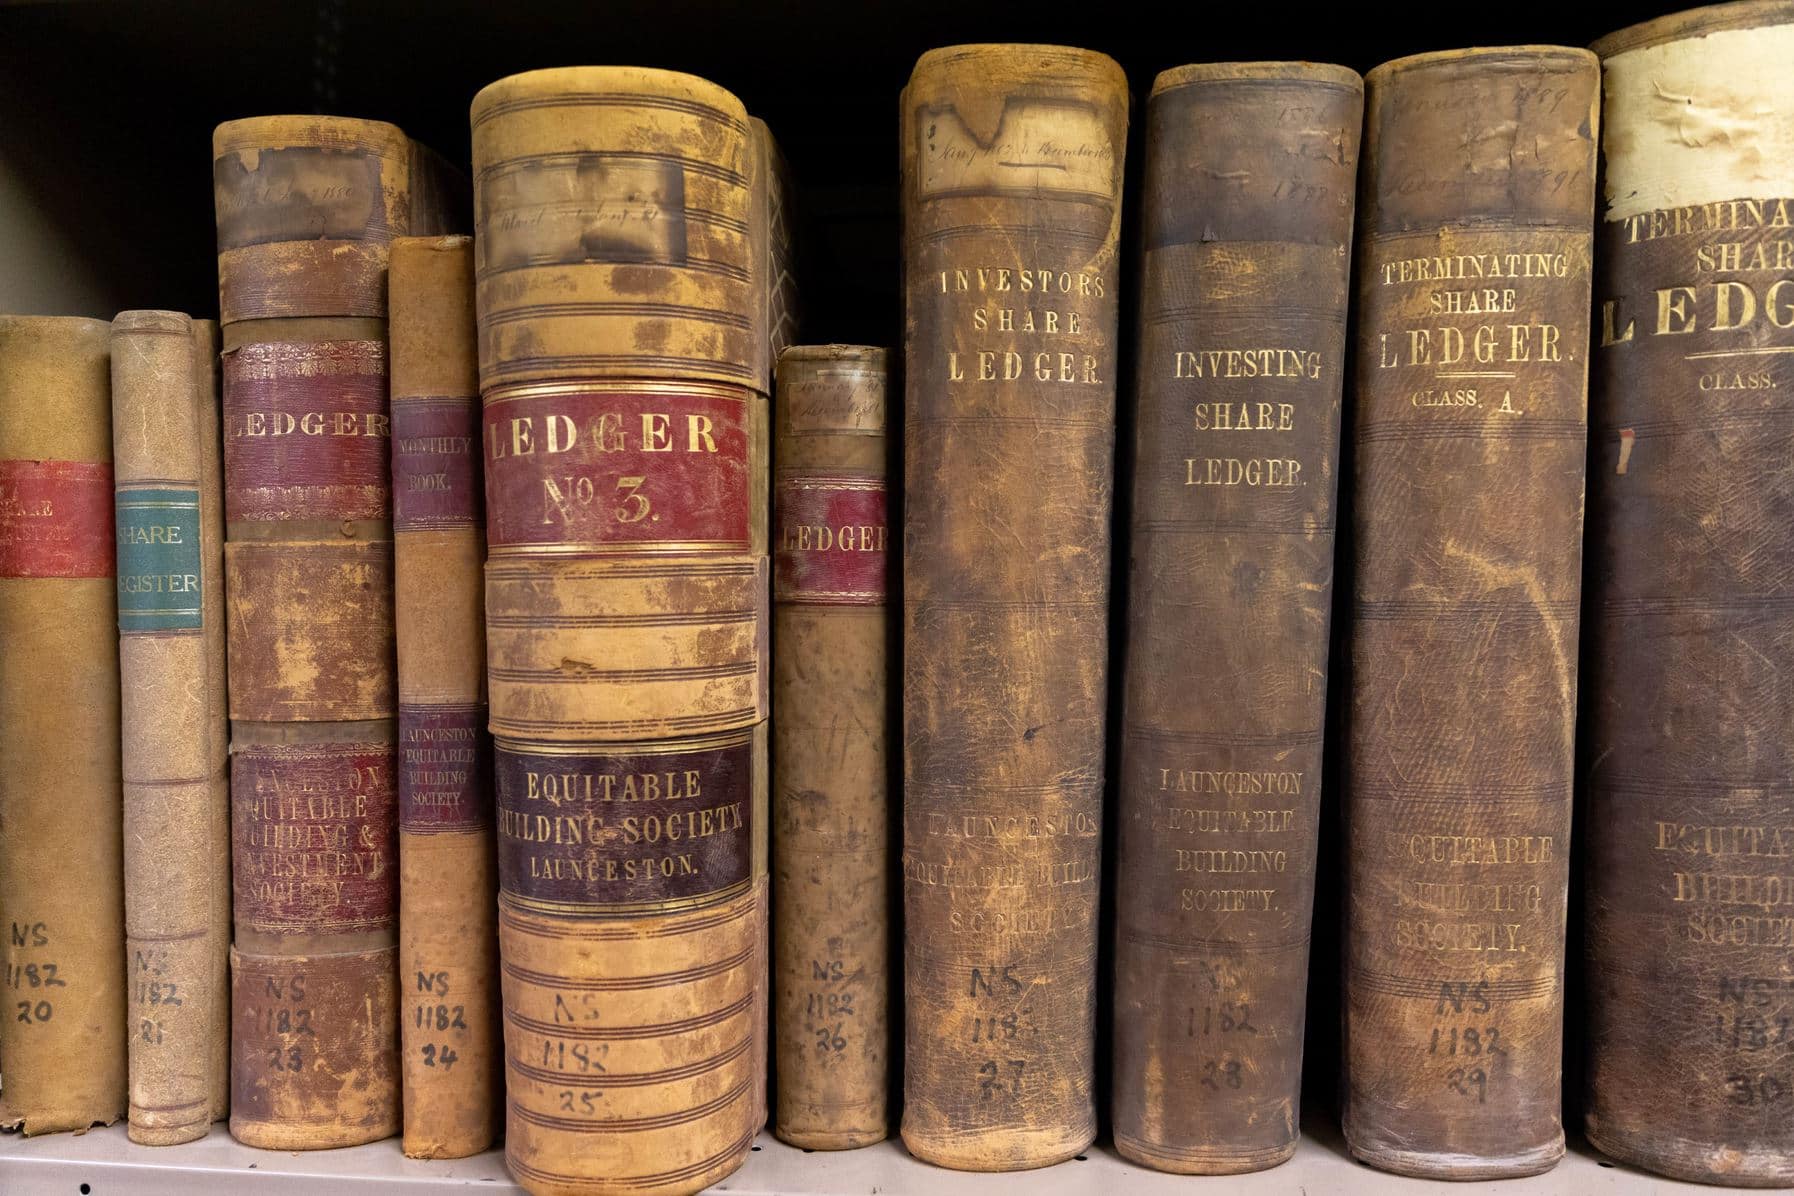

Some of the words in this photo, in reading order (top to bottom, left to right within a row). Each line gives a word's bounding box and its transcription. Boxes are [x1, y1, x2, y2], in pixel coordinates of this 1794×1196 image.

[941, 267, 1105, 298] INVESTORS
[1380, 253, 1569, 287] TERMINATING
[1429, 289, 1517, 315] SHARE
[973, 308, 1081, 335] SHARE
[1378, 323, 1574, 369] LEDGER.
[948, 351, 1104, 385] LEDGER.
[1173, 349, 1322, 380] INVESTING
[1700, 372, 1777, 391] CLASS.
[1411, 389, 1484, 409] CLASS.
[1498, 390, 1525, 415] A.
[1195, 402, 1295, 431] SHARE
[490, 413, 718, 460] LEDGER
[119, 526, 182, 545] HARE
[119, 574, 199, 593] EGISTER
[526, 770, 701, 807] EQUITABLE
[359, 825, 376, 849] &
[499, 806, 605, 846] BUILDING
[1175, 849, 1288, 873] BUILDING
[1397, 833, 1554, 865] QUITABLE
[531, 853, 698, 881] LAUNCESTON.
[12, 922, 48, 947] NS
[6, 963, 66, 989] 1182
[417, 971, 450, 997] NS
[812, 960, 844, 980] NS
[970, 963, 1023, 997] NS
[265, 975, 306, 1002] NS
[1437, 979, 1491, 1016] NS
[18, 1001, 52, 1024] 20
[416, 1004, 467, 1031] 1182
[815, 1022, 847, 1051] 26
[1429, 1027, 1508, 1057] 1182
[421, 1043, 458, 1071] 24
[543, 1040, 610, 1073] 1182
[979, 1060, 1025, 1098] 27
[1448, 1067, 1487, 1105] 29
[559, 1090, 603, 1116] 25
